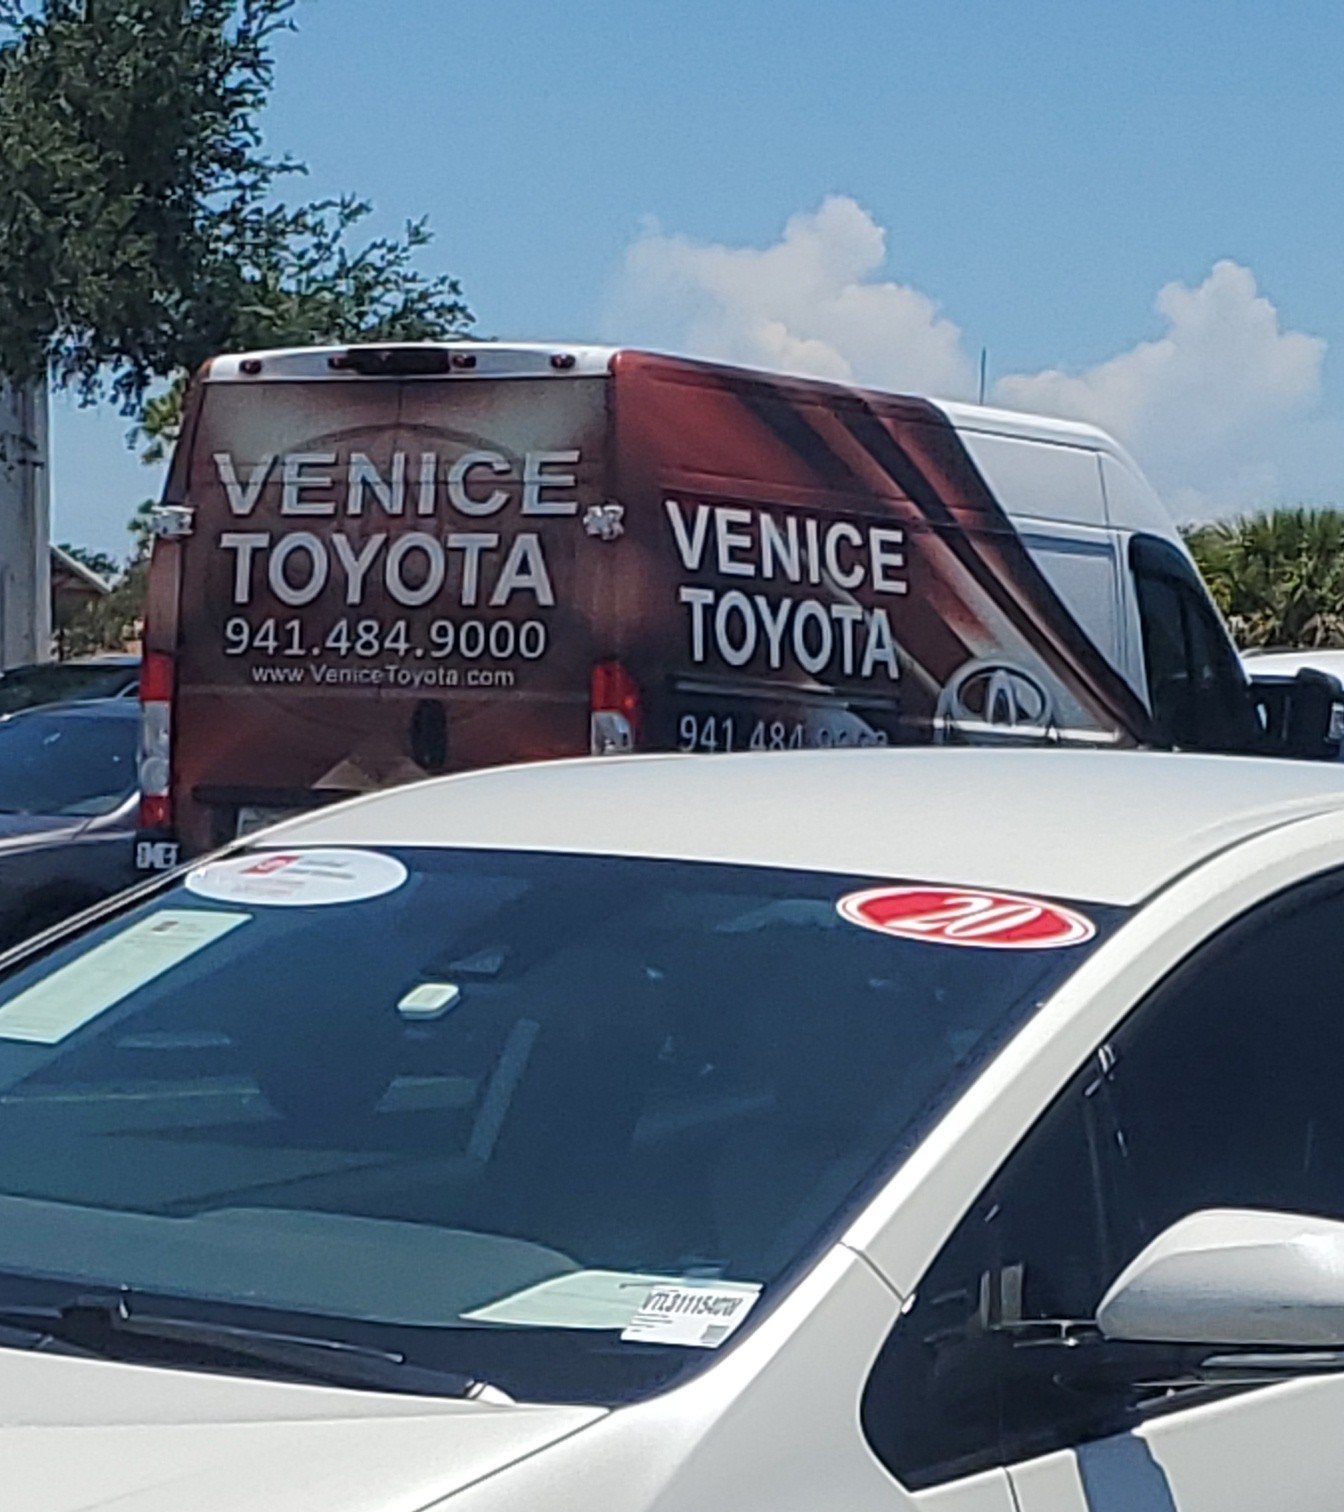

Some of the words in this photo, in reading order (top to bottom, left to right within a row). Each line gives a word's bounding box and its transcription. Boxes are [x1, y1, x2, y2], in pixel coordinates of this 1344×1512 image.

[212, 449, 581, 517] VENICE
[219, 531, 556, 608] TOYOTA
[665, 500, 908, 595] VENICE
[224, 616, 547, 660] 941.484.9000
[679, 586, 900, 680] TOYOTA
[883, 897, 1043, 937] 20
